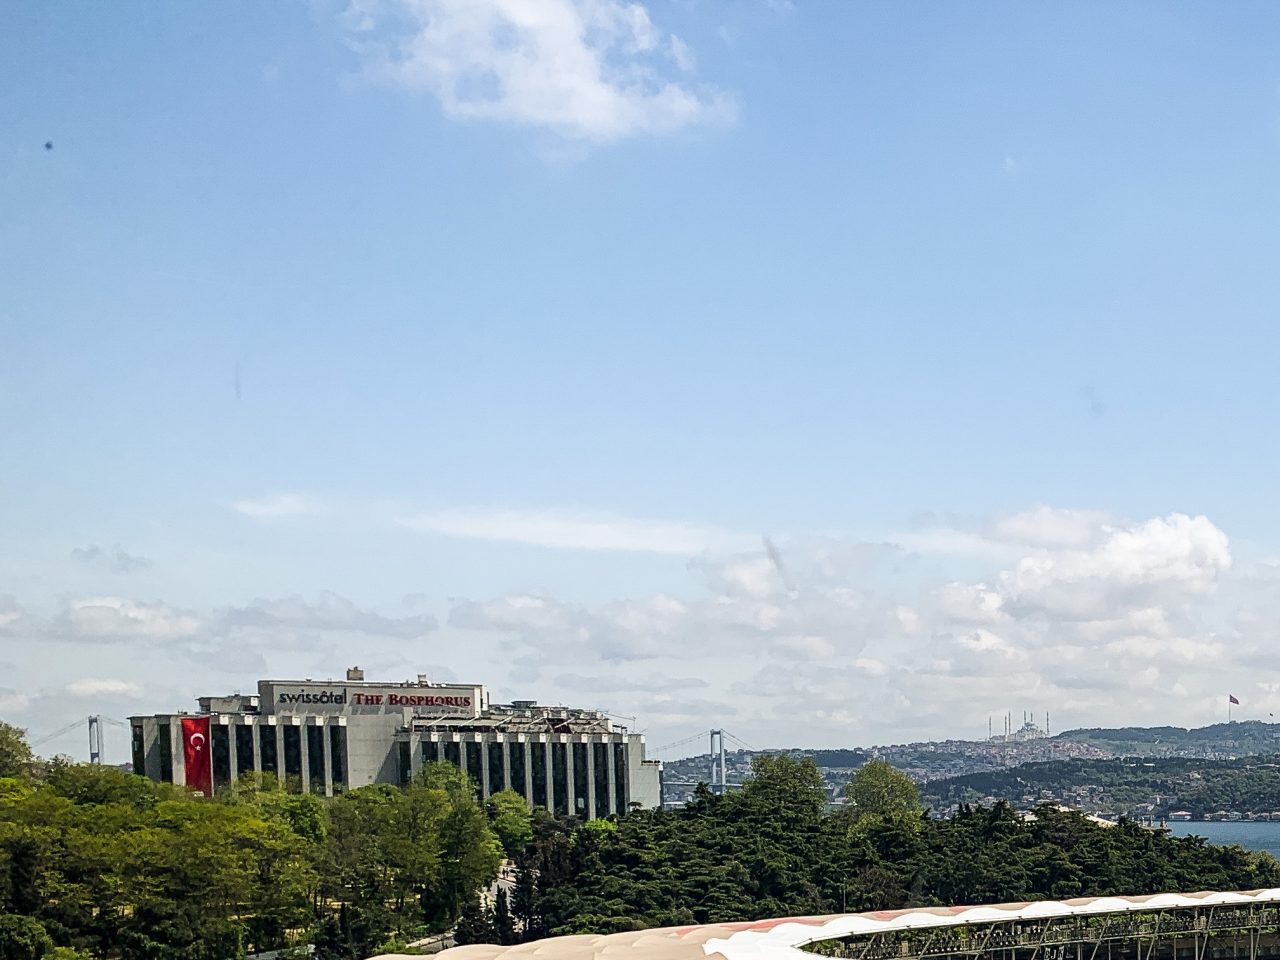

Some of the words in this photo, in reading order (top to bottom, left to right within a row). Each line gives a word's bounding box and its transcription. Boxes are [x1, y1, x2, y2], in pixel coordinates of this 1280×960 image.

[280, 688, 347, 705] swissôtel
[353, 692, 383, 706] THE
[388, 693, 471, 707] BOSPHORUS
